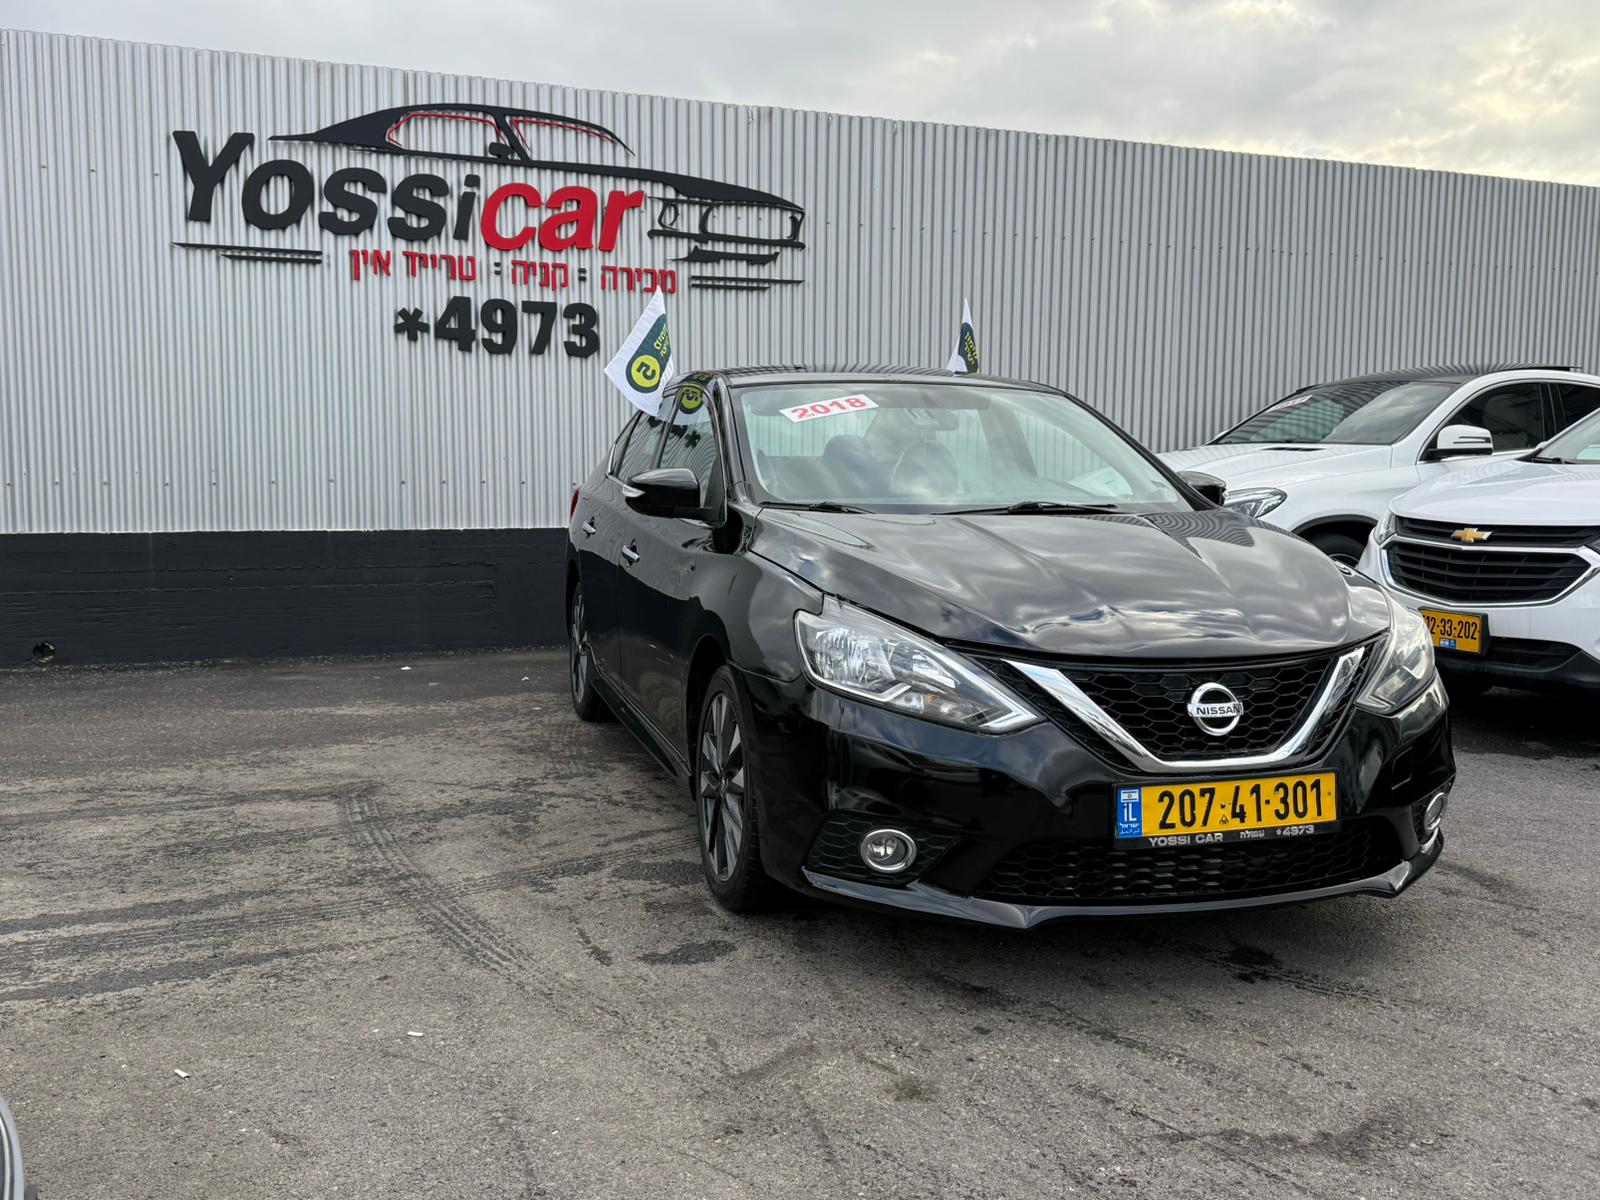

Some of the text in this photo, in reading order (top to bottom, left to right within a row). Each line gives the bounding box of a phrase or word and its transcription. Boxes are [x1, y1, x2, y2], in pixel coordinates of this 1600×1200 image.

[349, 249, 676, 294] מכירה קניה טרייד אין
[791, 398, 866, 419] 2018
[1196, 703, 1241, 715] NISSAN
[1149, 832, 1224, 847] YOSSI CAR
